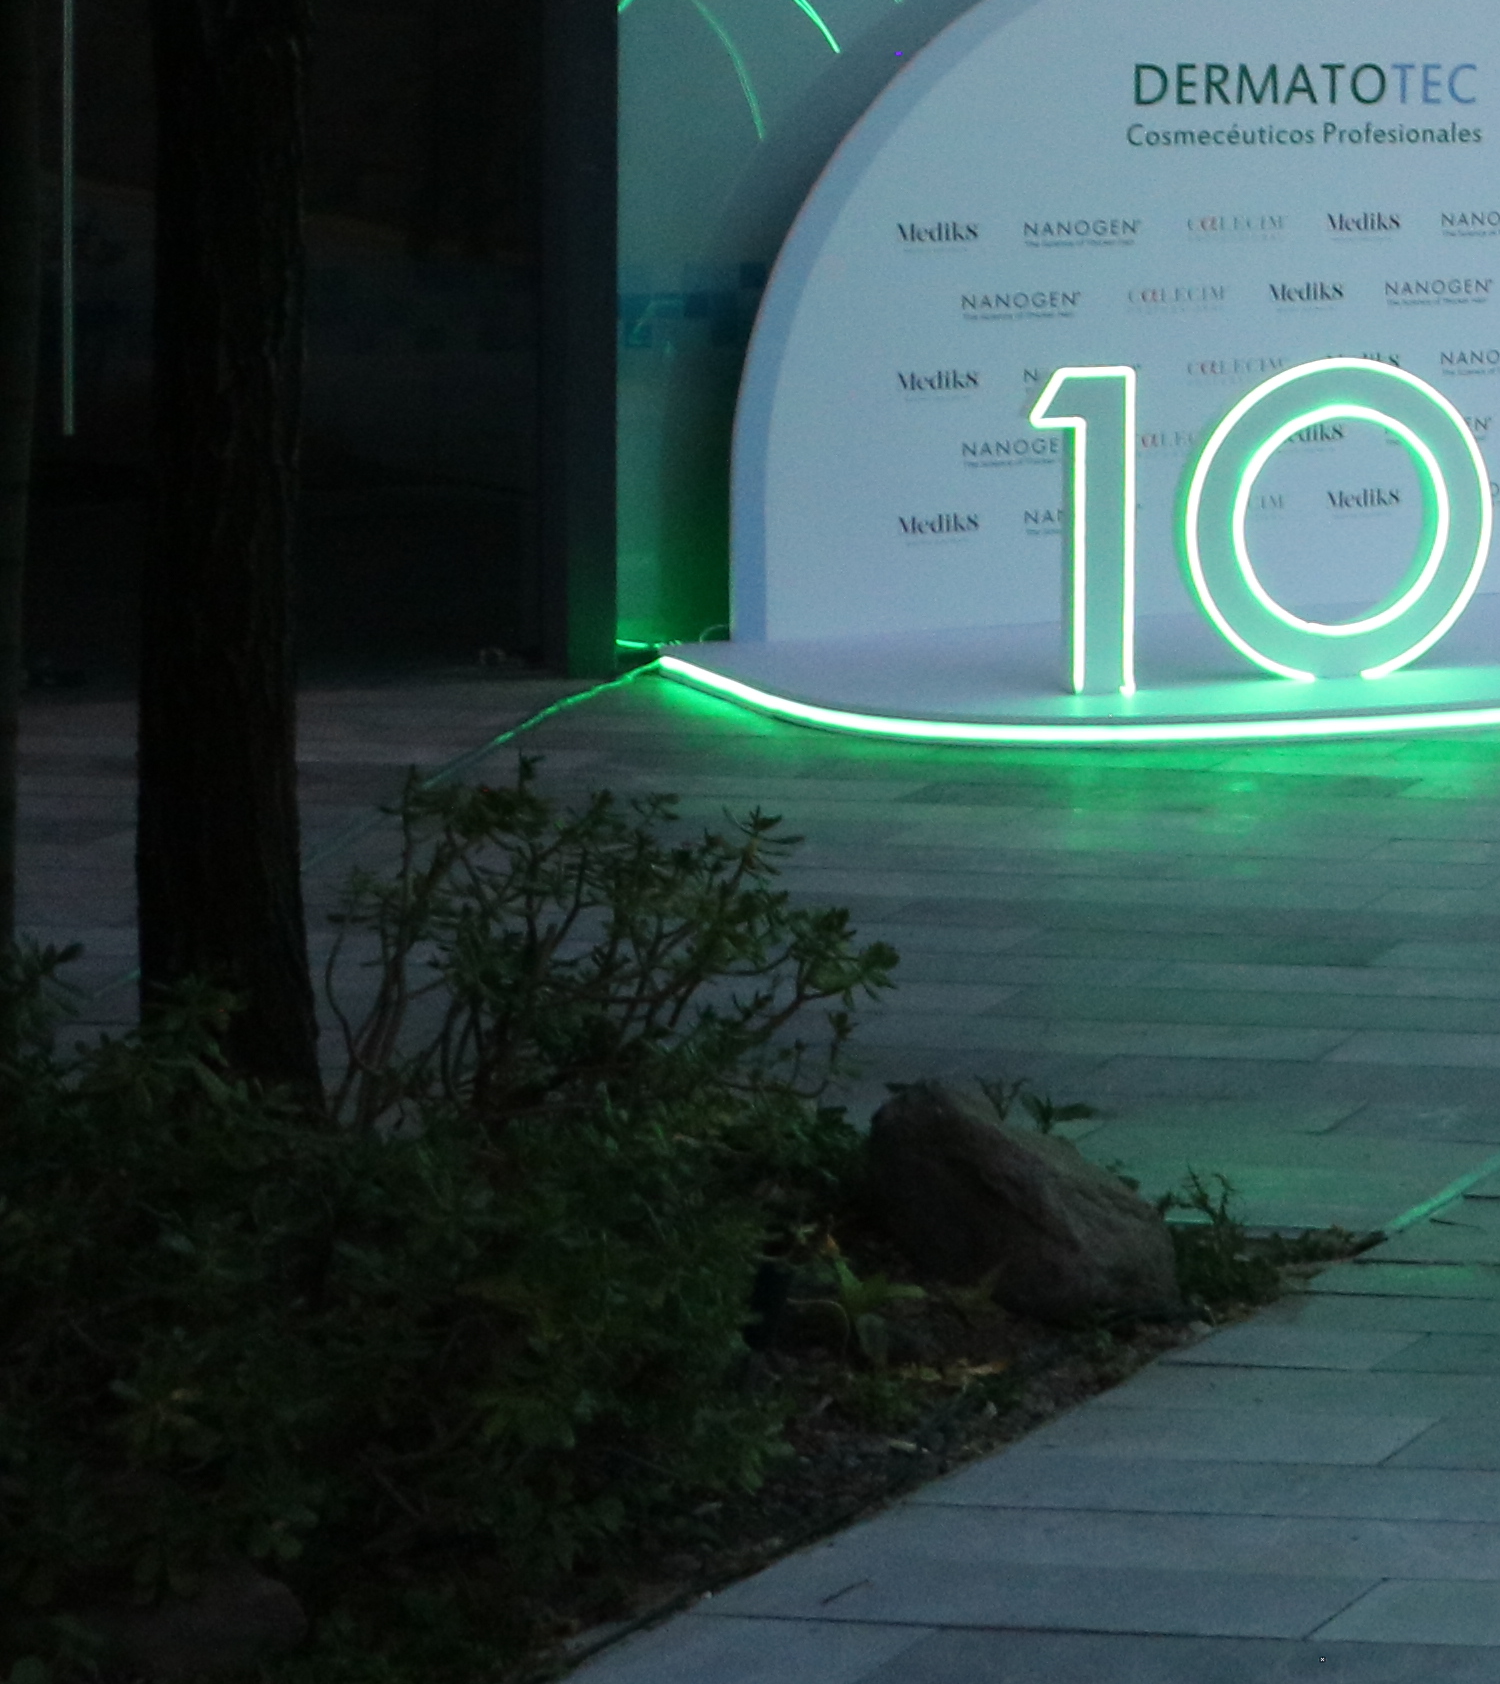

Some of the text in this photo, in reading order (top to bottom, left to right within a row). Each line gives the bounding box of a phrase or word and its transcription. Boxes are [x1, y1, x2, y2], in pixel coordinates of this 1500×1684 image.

[1133, 62, 1478, 106] DERMATOTEC
[1126, 121, 1483, 147] Cosmecéuticos Profesionales
[962, 437, 1060, 456] NANOGE
[1029, 356, 1493, 694] 10
